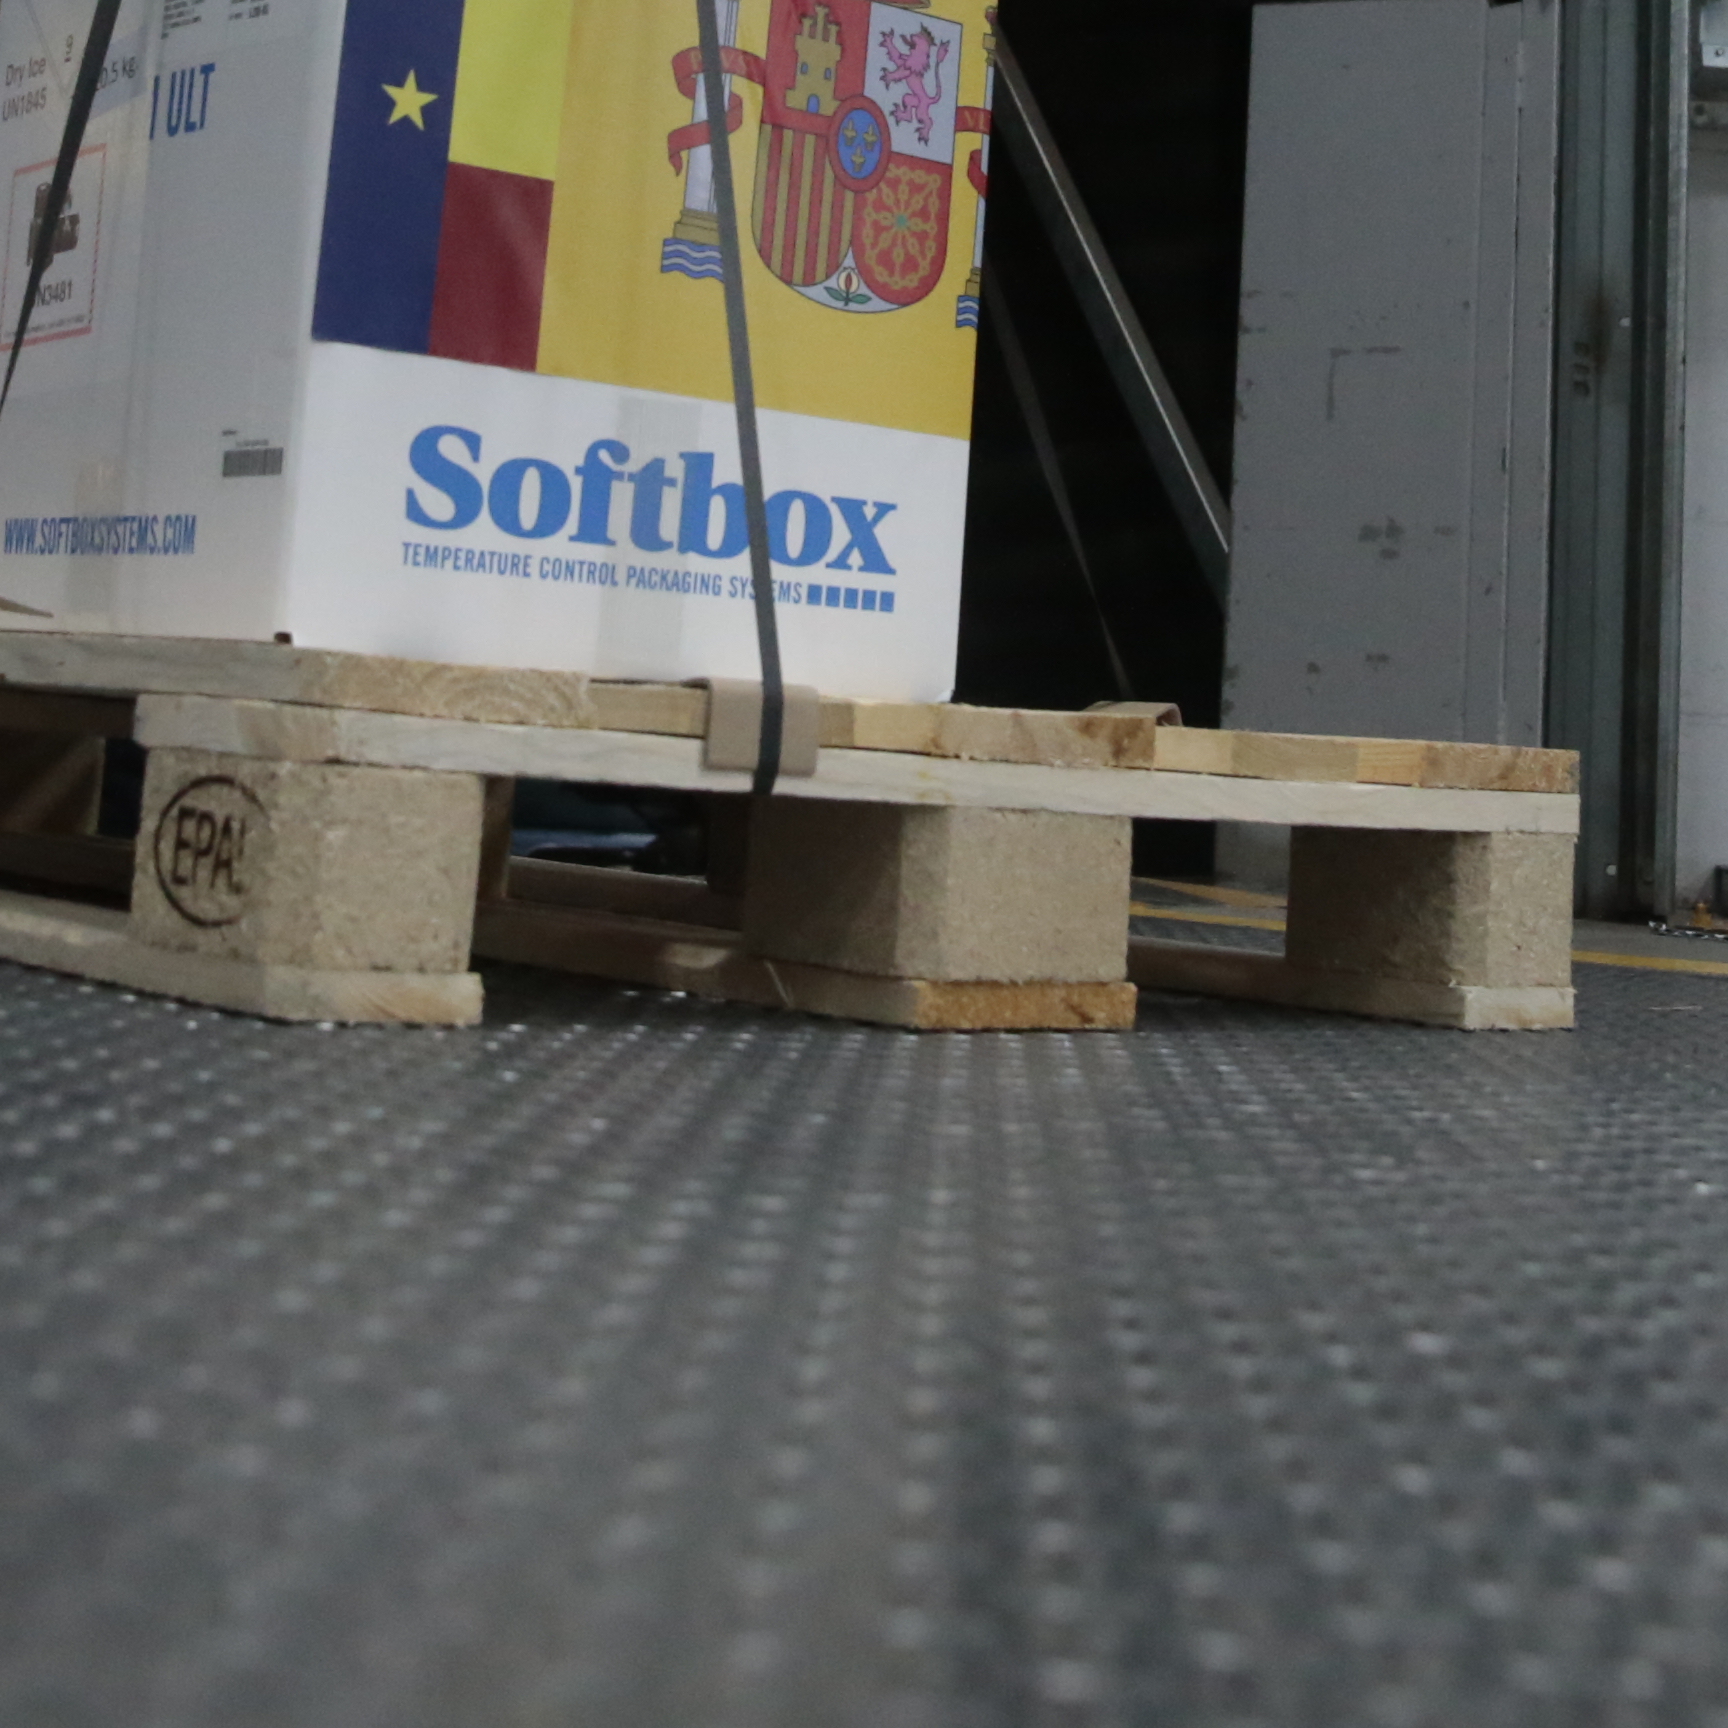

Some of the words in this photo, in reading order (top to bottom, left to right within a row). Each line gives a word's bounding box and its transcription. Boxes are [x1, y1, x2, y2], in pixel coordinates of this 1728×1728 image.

[5, 63, 25, 88] Dry
[28, 57, 47, 78] Ice
[2, 87, 47, 122] UN1845
[35, 279, 74, 308] N3481
[404, 424, 898, 576] Softbox
[3, 515, 197, 556] WWW.SOFTBOXSYSTEMS.COM
[401, 542, 532, 580] TEMPERATURE
[538, 557, 619, 588] CONTROL
[626, 565, 723, 598] PACKAGING
